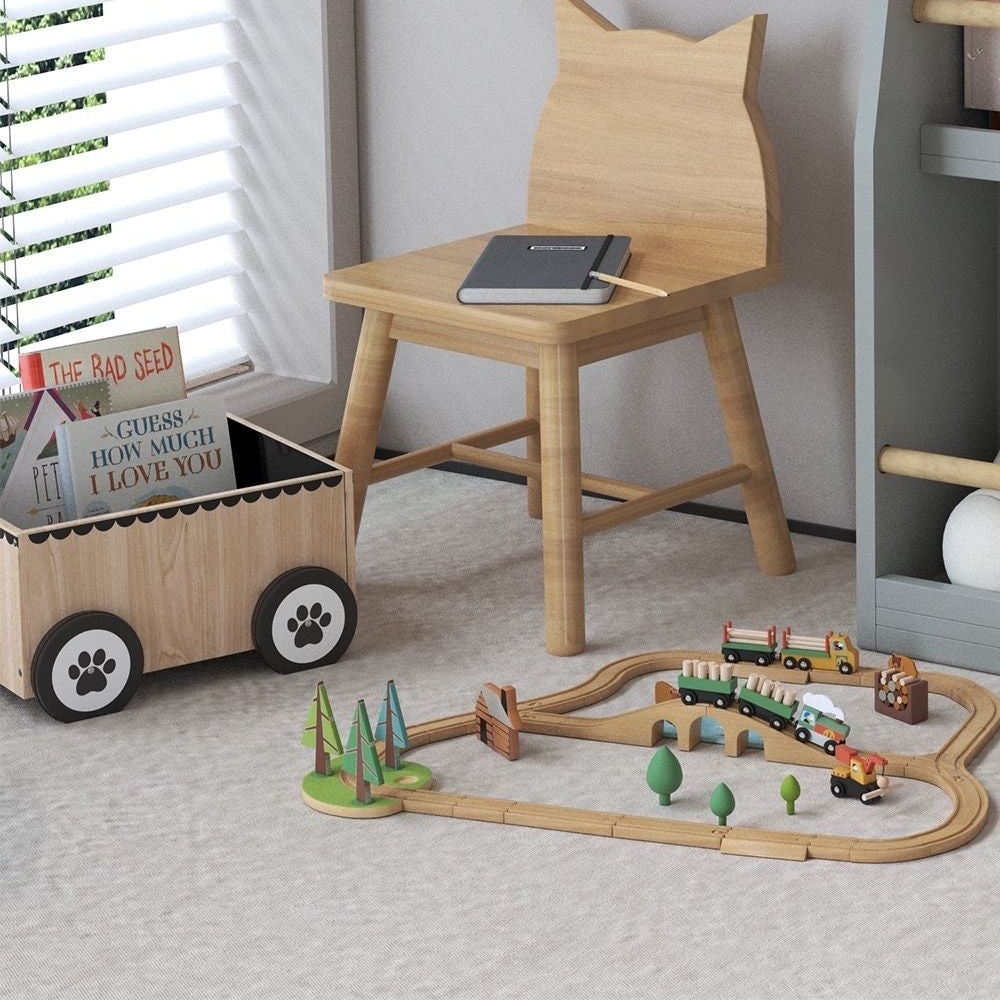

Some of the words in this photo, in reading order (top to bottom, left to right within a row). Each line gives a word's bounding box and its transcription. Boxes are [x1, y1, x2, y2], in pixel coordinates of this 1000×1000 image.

[49, 360, 82, 385] THE
[134, 342, 174, 381] SEED
[117, 409, 184, 439] GUESS
[90, 441, 143, 470] HOW
[150, 426, 215, 457] MUCH
[89, 474, 99, 496] I
[107, 460, 169, 493] LOVE
[173, 448, 222, 477] YOU
